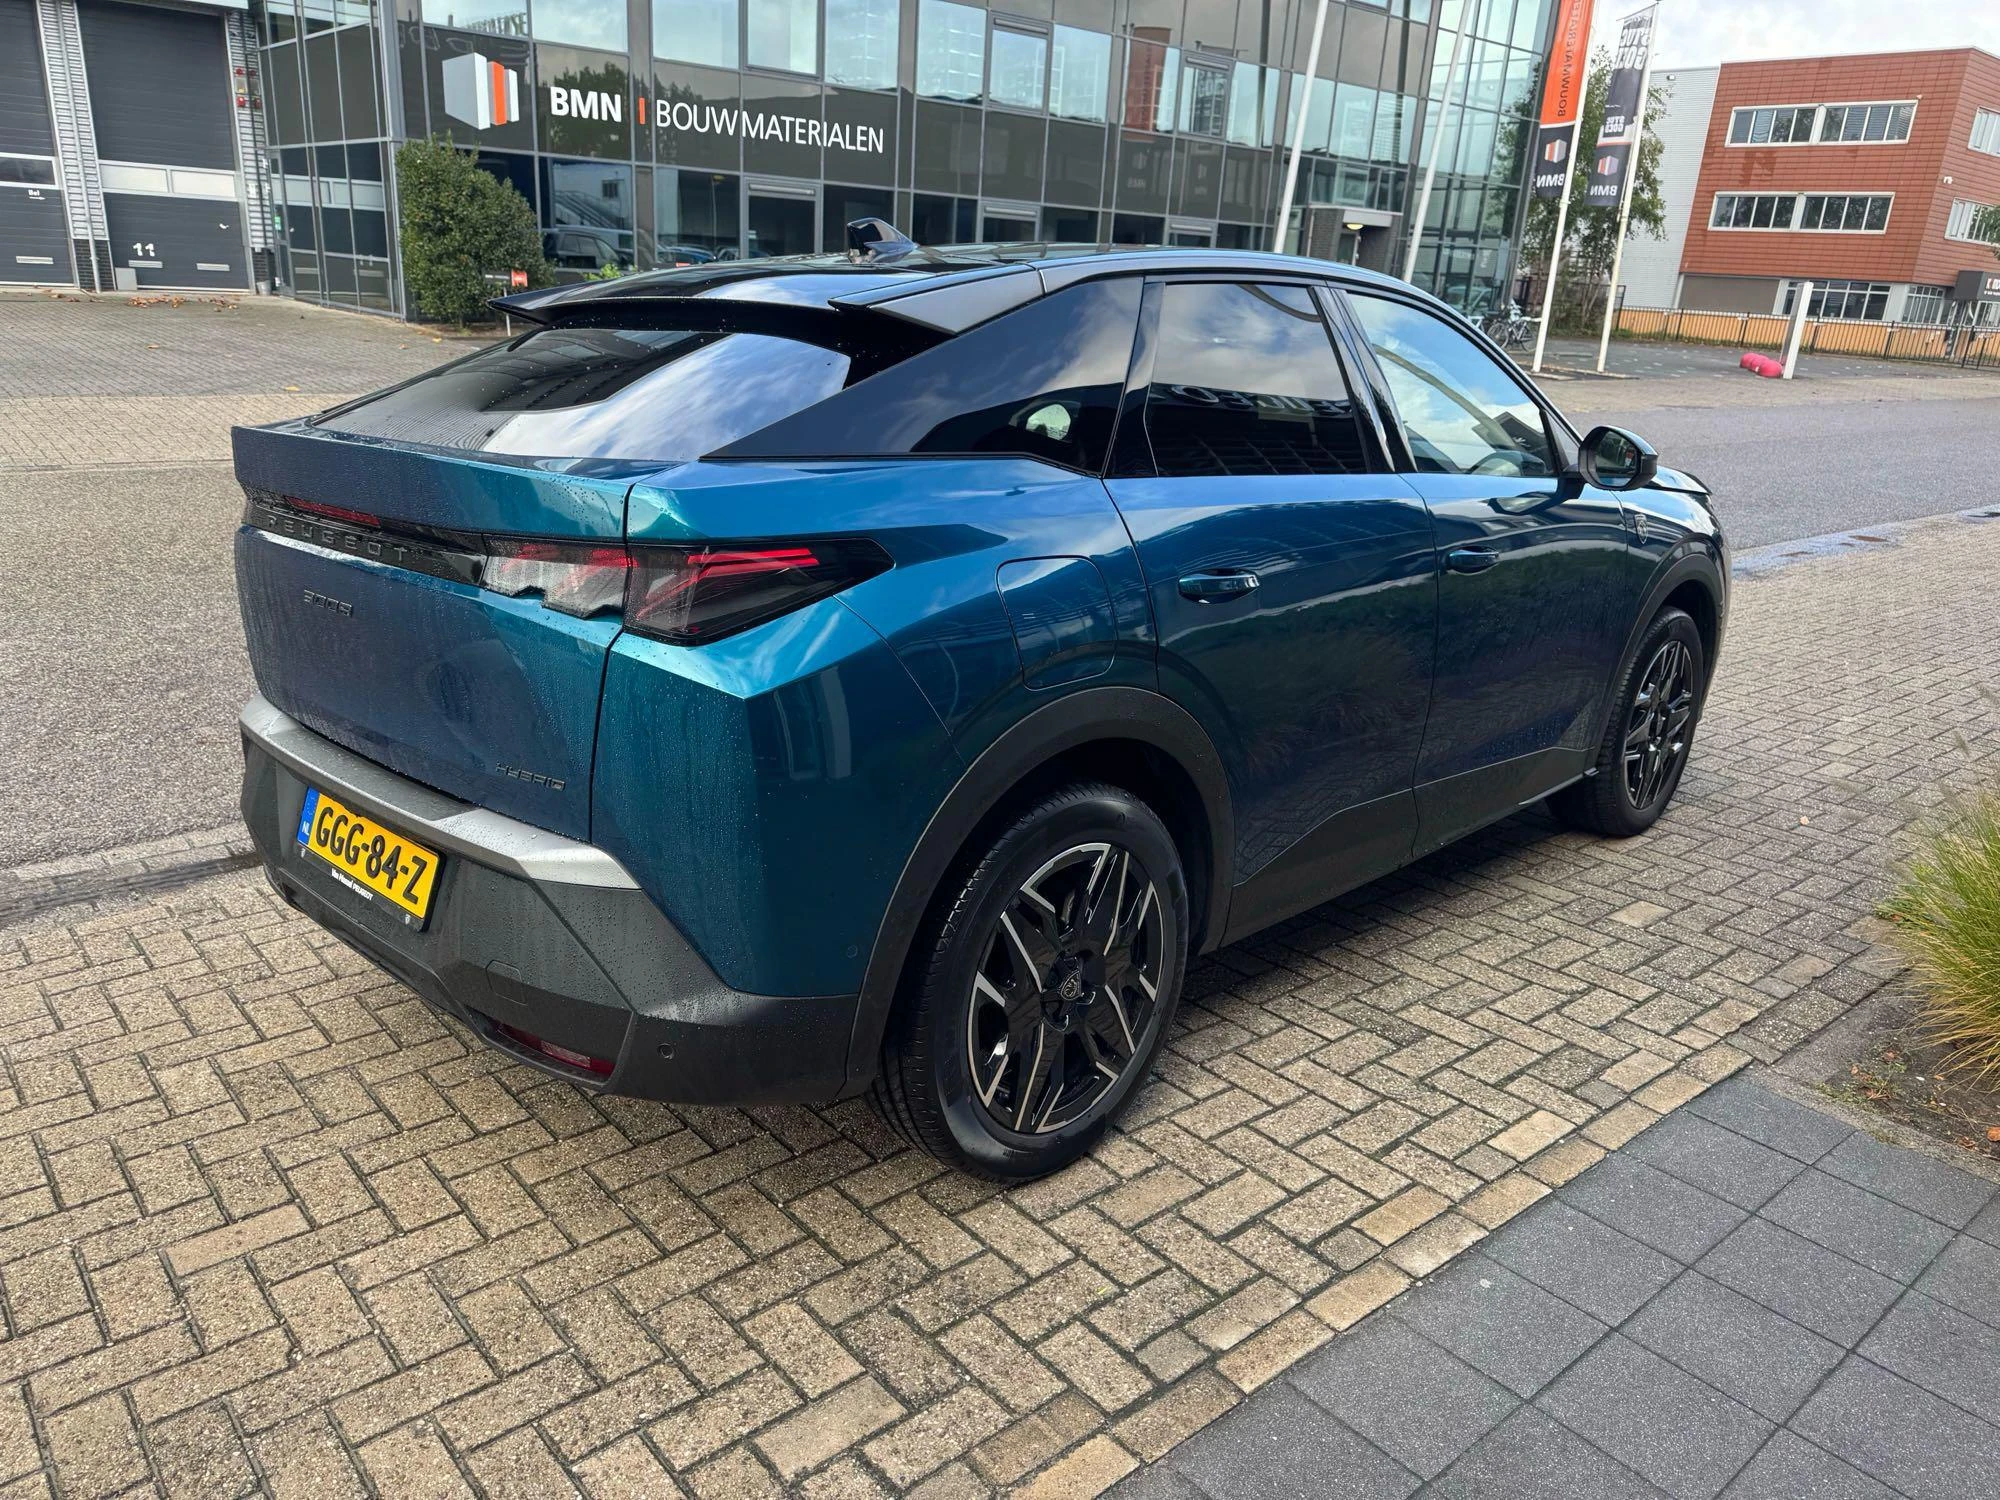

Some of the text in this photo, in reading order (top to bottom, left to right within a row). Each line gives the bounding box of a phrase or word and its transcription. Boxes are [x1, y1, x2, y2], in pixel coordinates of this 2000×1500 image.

[549, 86, 884, 153] BMN BOUWMATERIALEN
[132, 242, 156, 257] 11
[267, 515, 407, 561] PEUGEOT
[303, 589, 353, 617] 3008
[495, 761, 566, 792] HYBRID
[301, 820, 310, 836] NL
[315, 806, 428, 905] GGG-84-Z
